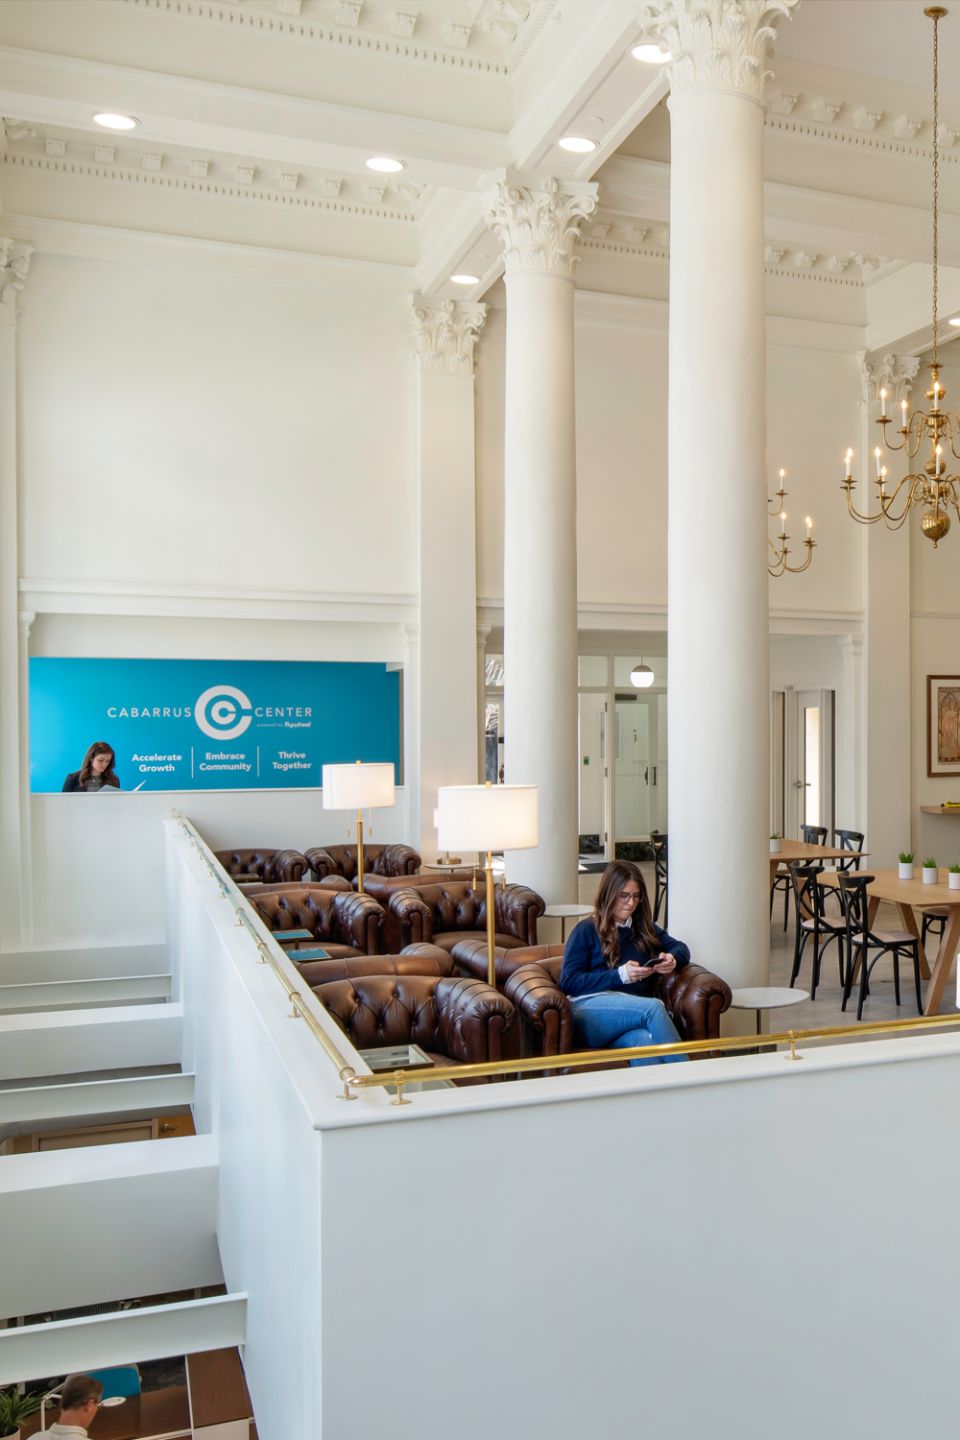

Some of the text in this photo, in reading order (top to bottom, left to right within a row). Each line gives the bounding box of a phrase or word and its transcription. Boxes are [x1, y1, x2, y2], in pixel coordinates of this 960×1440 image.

[107, 706, 313, 718] CABARRUS CENTER
[131, 753, 183, 762] Accelerate
[205, 752, 246, 761] Embrace
[278, 751, 307, 760] Thrive
[138, 763, 176, 773] Growth
[199, 762, 252, 773] Community
[272, 761, 313, 771] Together
